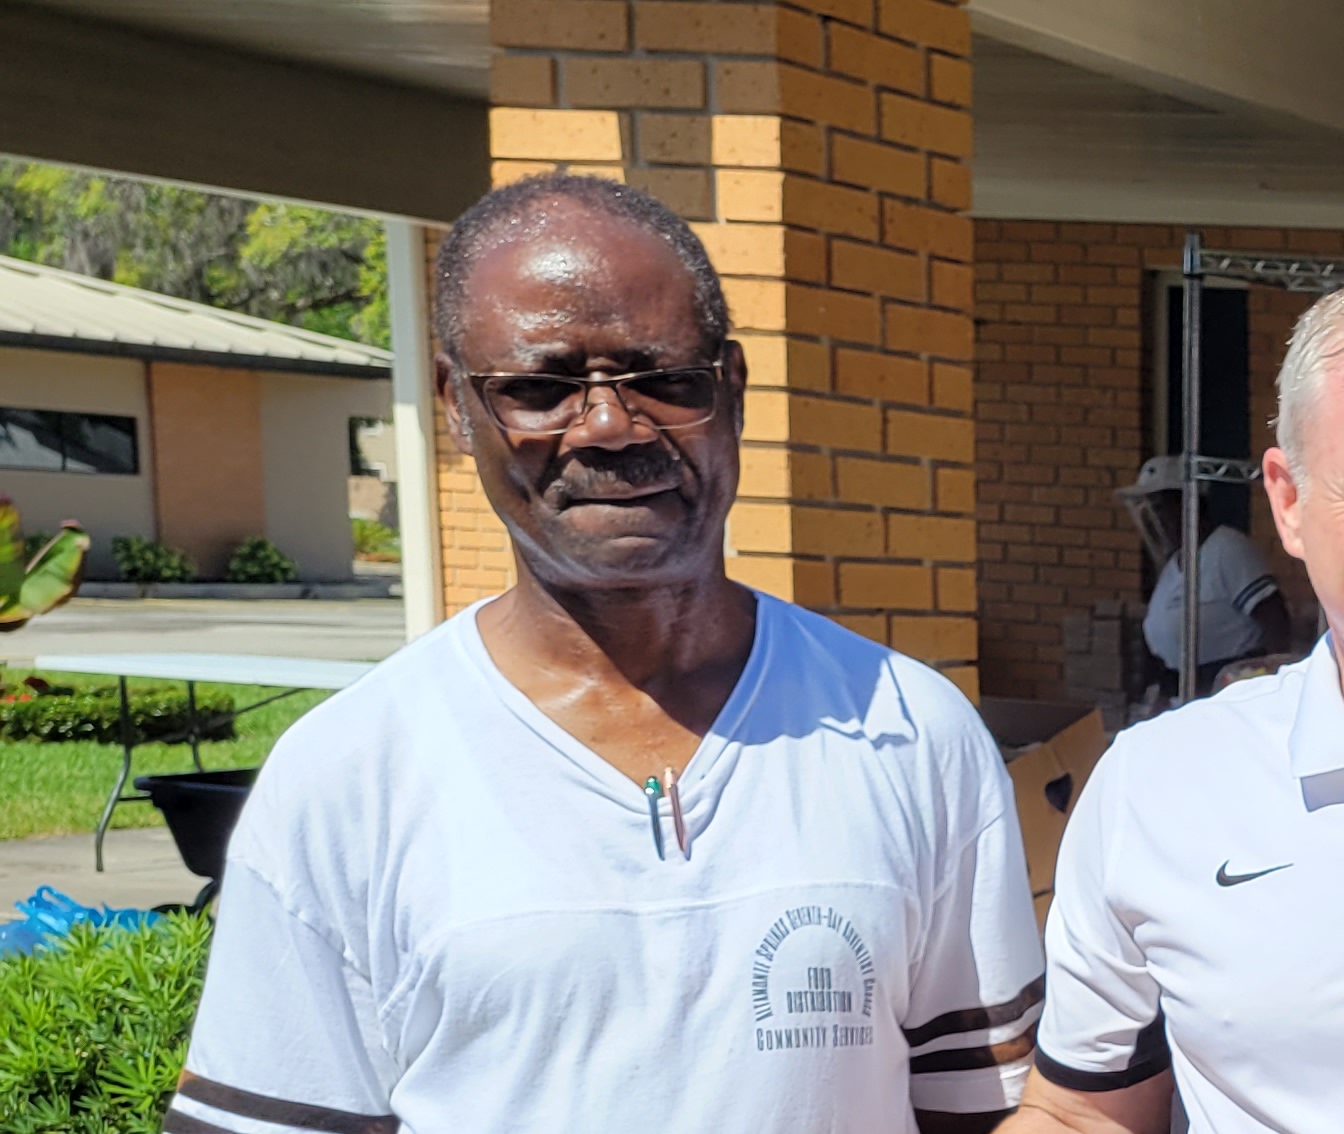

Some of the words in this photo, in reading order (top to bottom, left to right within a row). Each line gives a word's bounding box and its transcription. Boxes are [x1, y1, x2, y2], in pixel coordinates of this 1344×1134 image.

[807, 967, 832, 990] FOOD
[786, 991, 852, 1014] DISTRIBUTION
[756, 1027, 827, 1051] COMMUNITY
[832, 1024, 873, 1047] SERVICES
